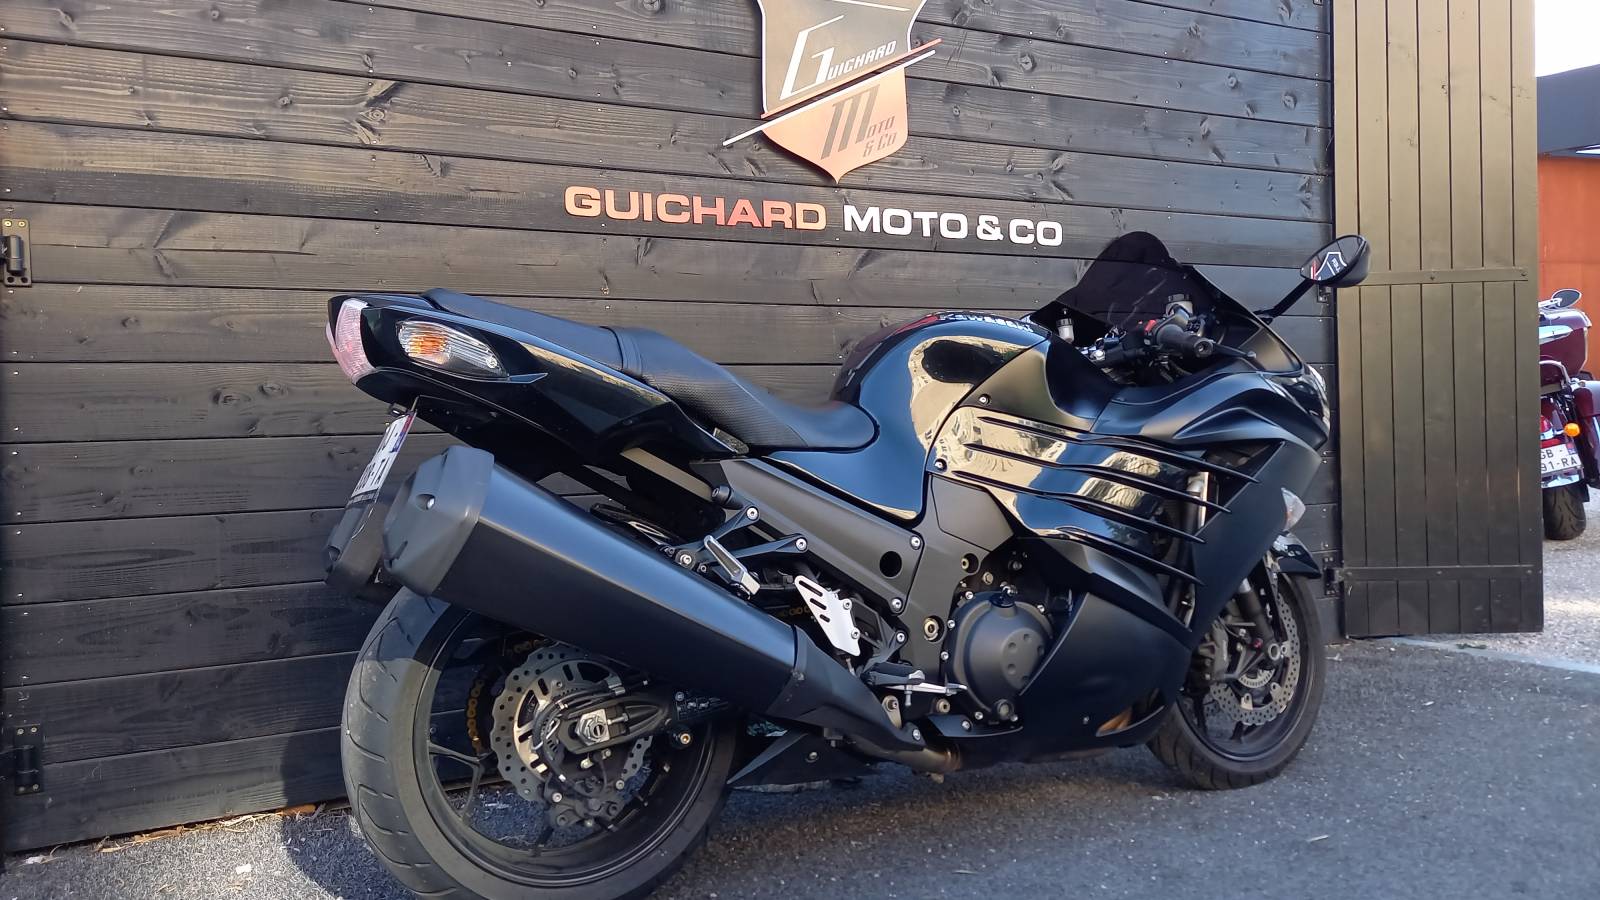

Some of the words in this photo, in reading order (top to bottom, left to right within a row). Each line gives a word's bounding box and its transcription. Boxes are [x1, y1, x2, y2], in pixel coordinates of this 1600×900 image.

[780, 15, 897, 100] GUICHARD
[564, 186, 827, 231] GUICHARD
[843, 204, 969, 240] MOTO
[976, 214, 1004, 241] &
[1008, 218, 1064, 247] CO
